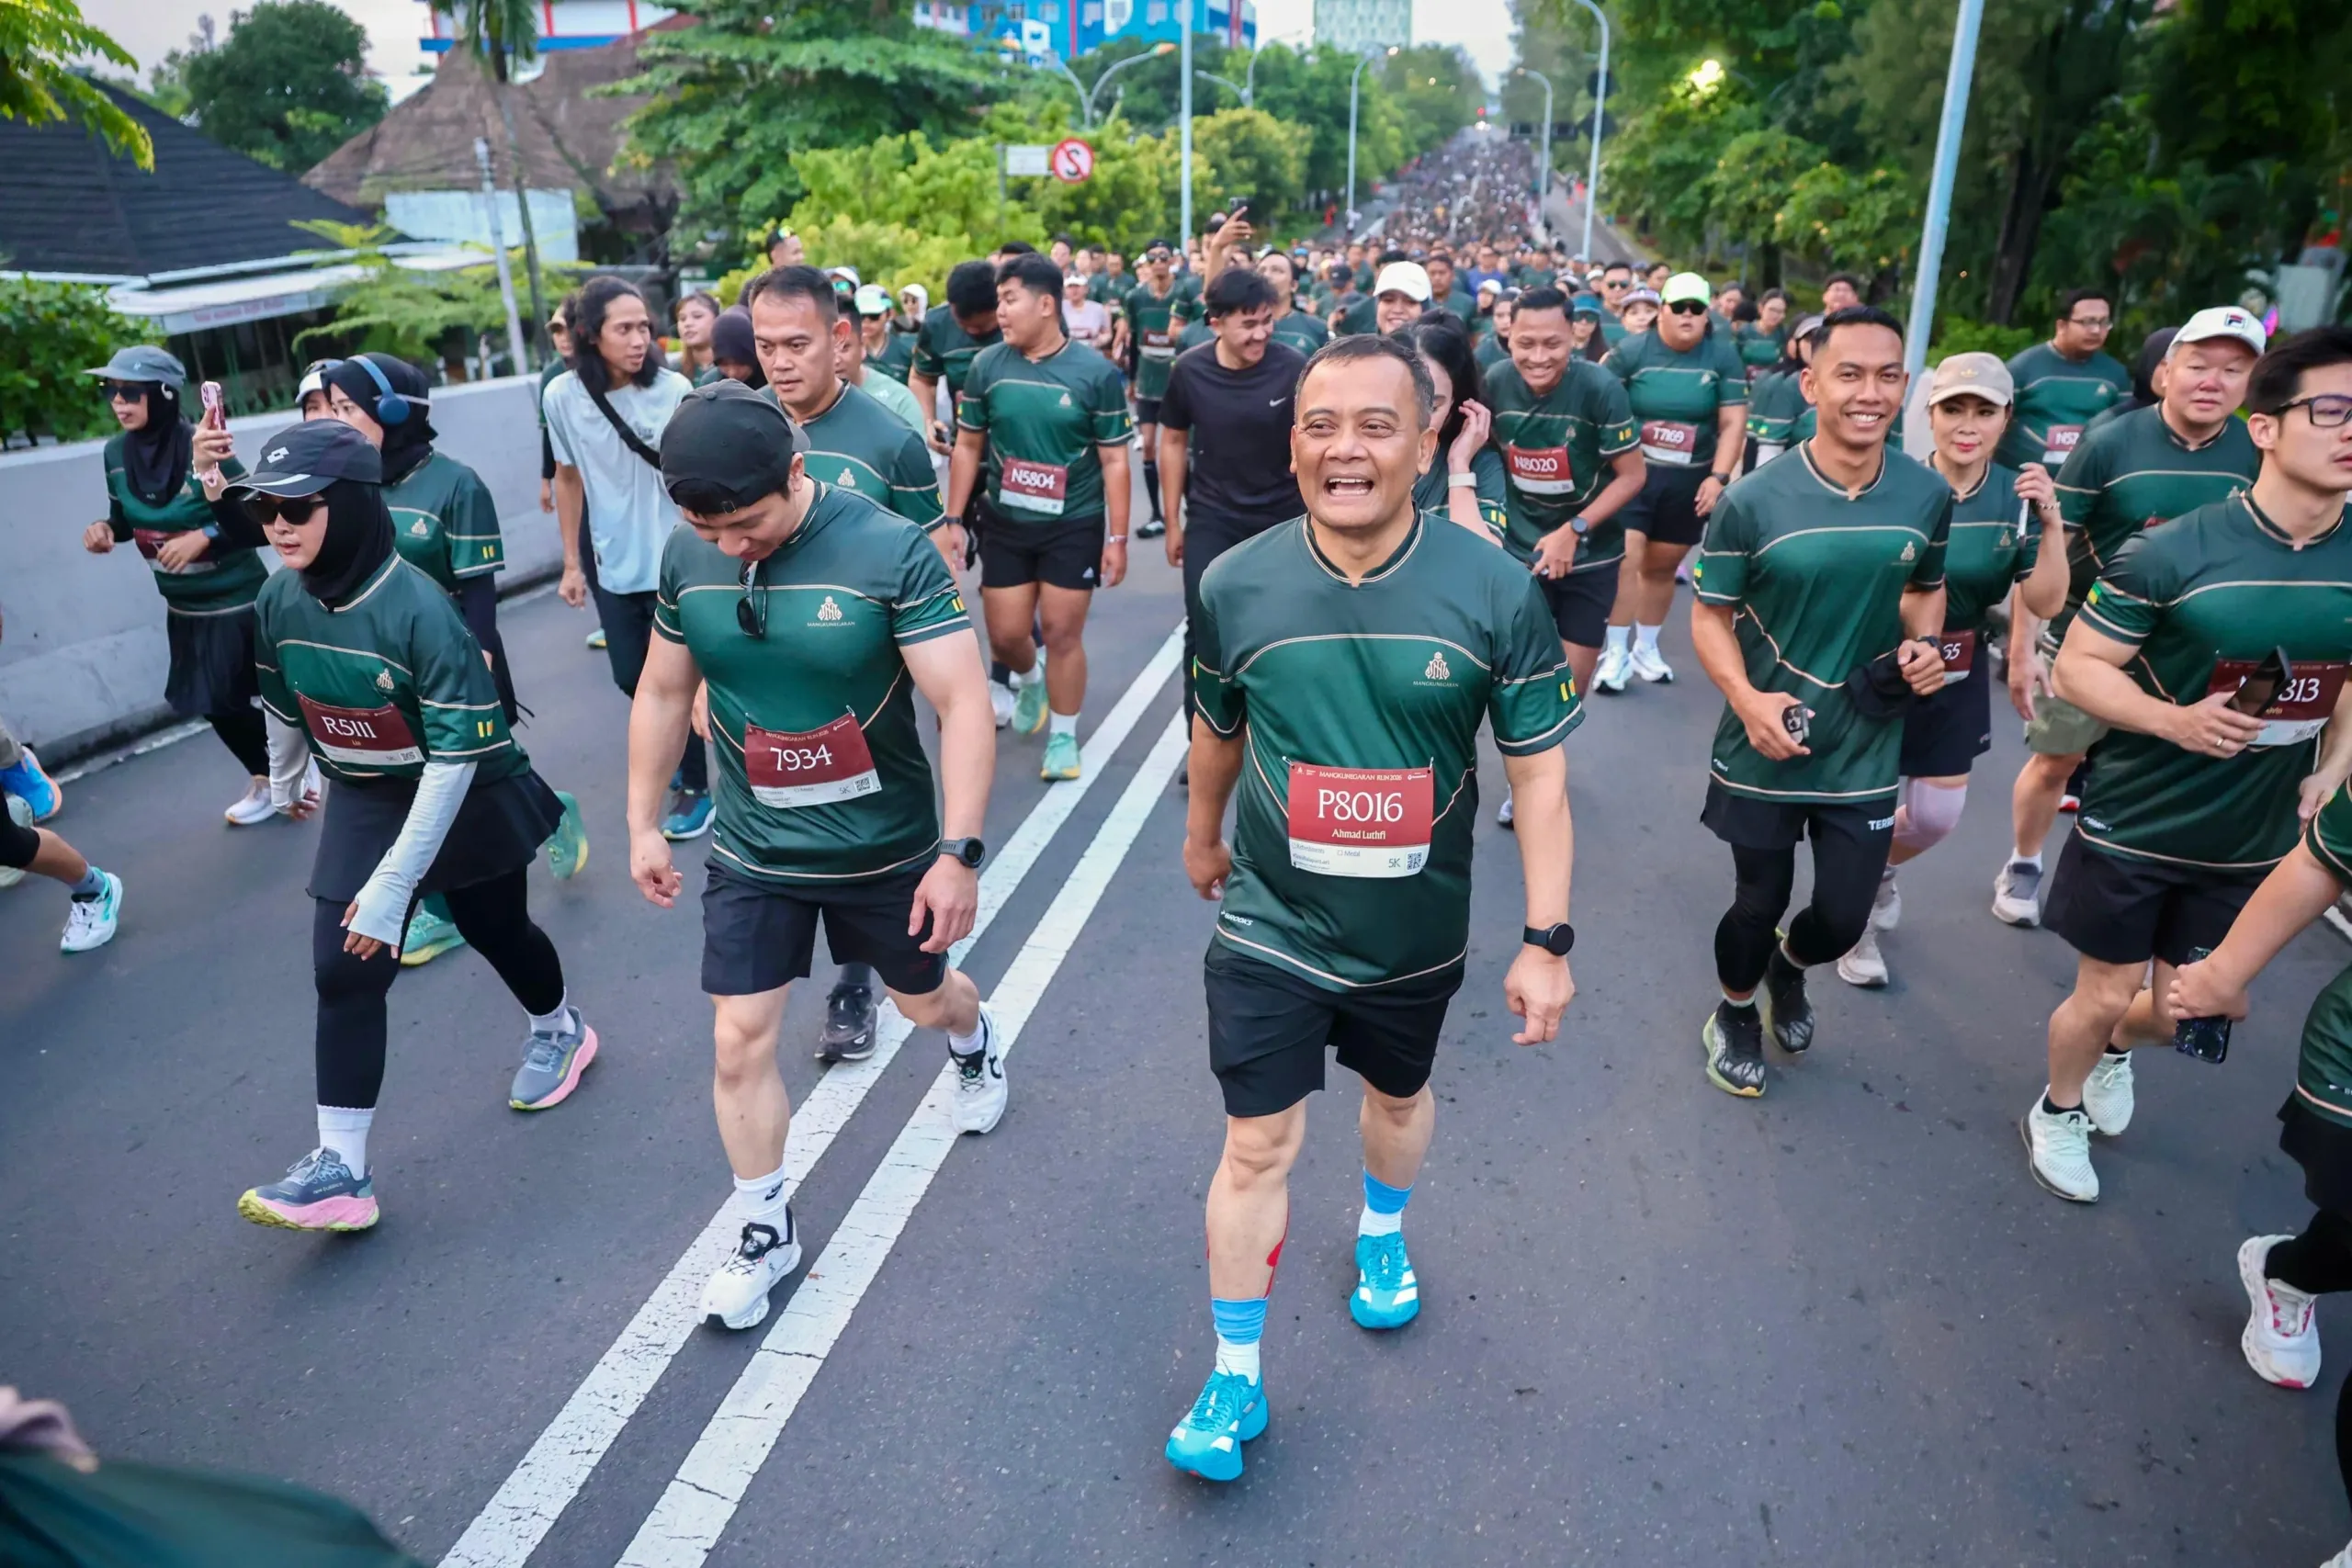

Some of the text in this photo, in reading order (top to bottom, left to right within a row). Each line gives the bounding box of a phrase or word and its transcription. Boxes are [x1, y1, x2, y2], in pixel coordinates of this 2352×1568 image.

[1513, 455, 1558, 472] N8020
[1011, 467, 1056, 490] N5804
[322, 716, 378, 739] R5111
[769, 743, 832, 772] 7934
[1319, 771, 1375, 781] MANGKUNEGARAN
[1317, 788, 1404, 823] P8016
[1331, 829, 1386, 840] Ahmad Luthfi
[1388, 858, 1401, 868] 5K
[1224, 912, 1254, 926] BROOKS
